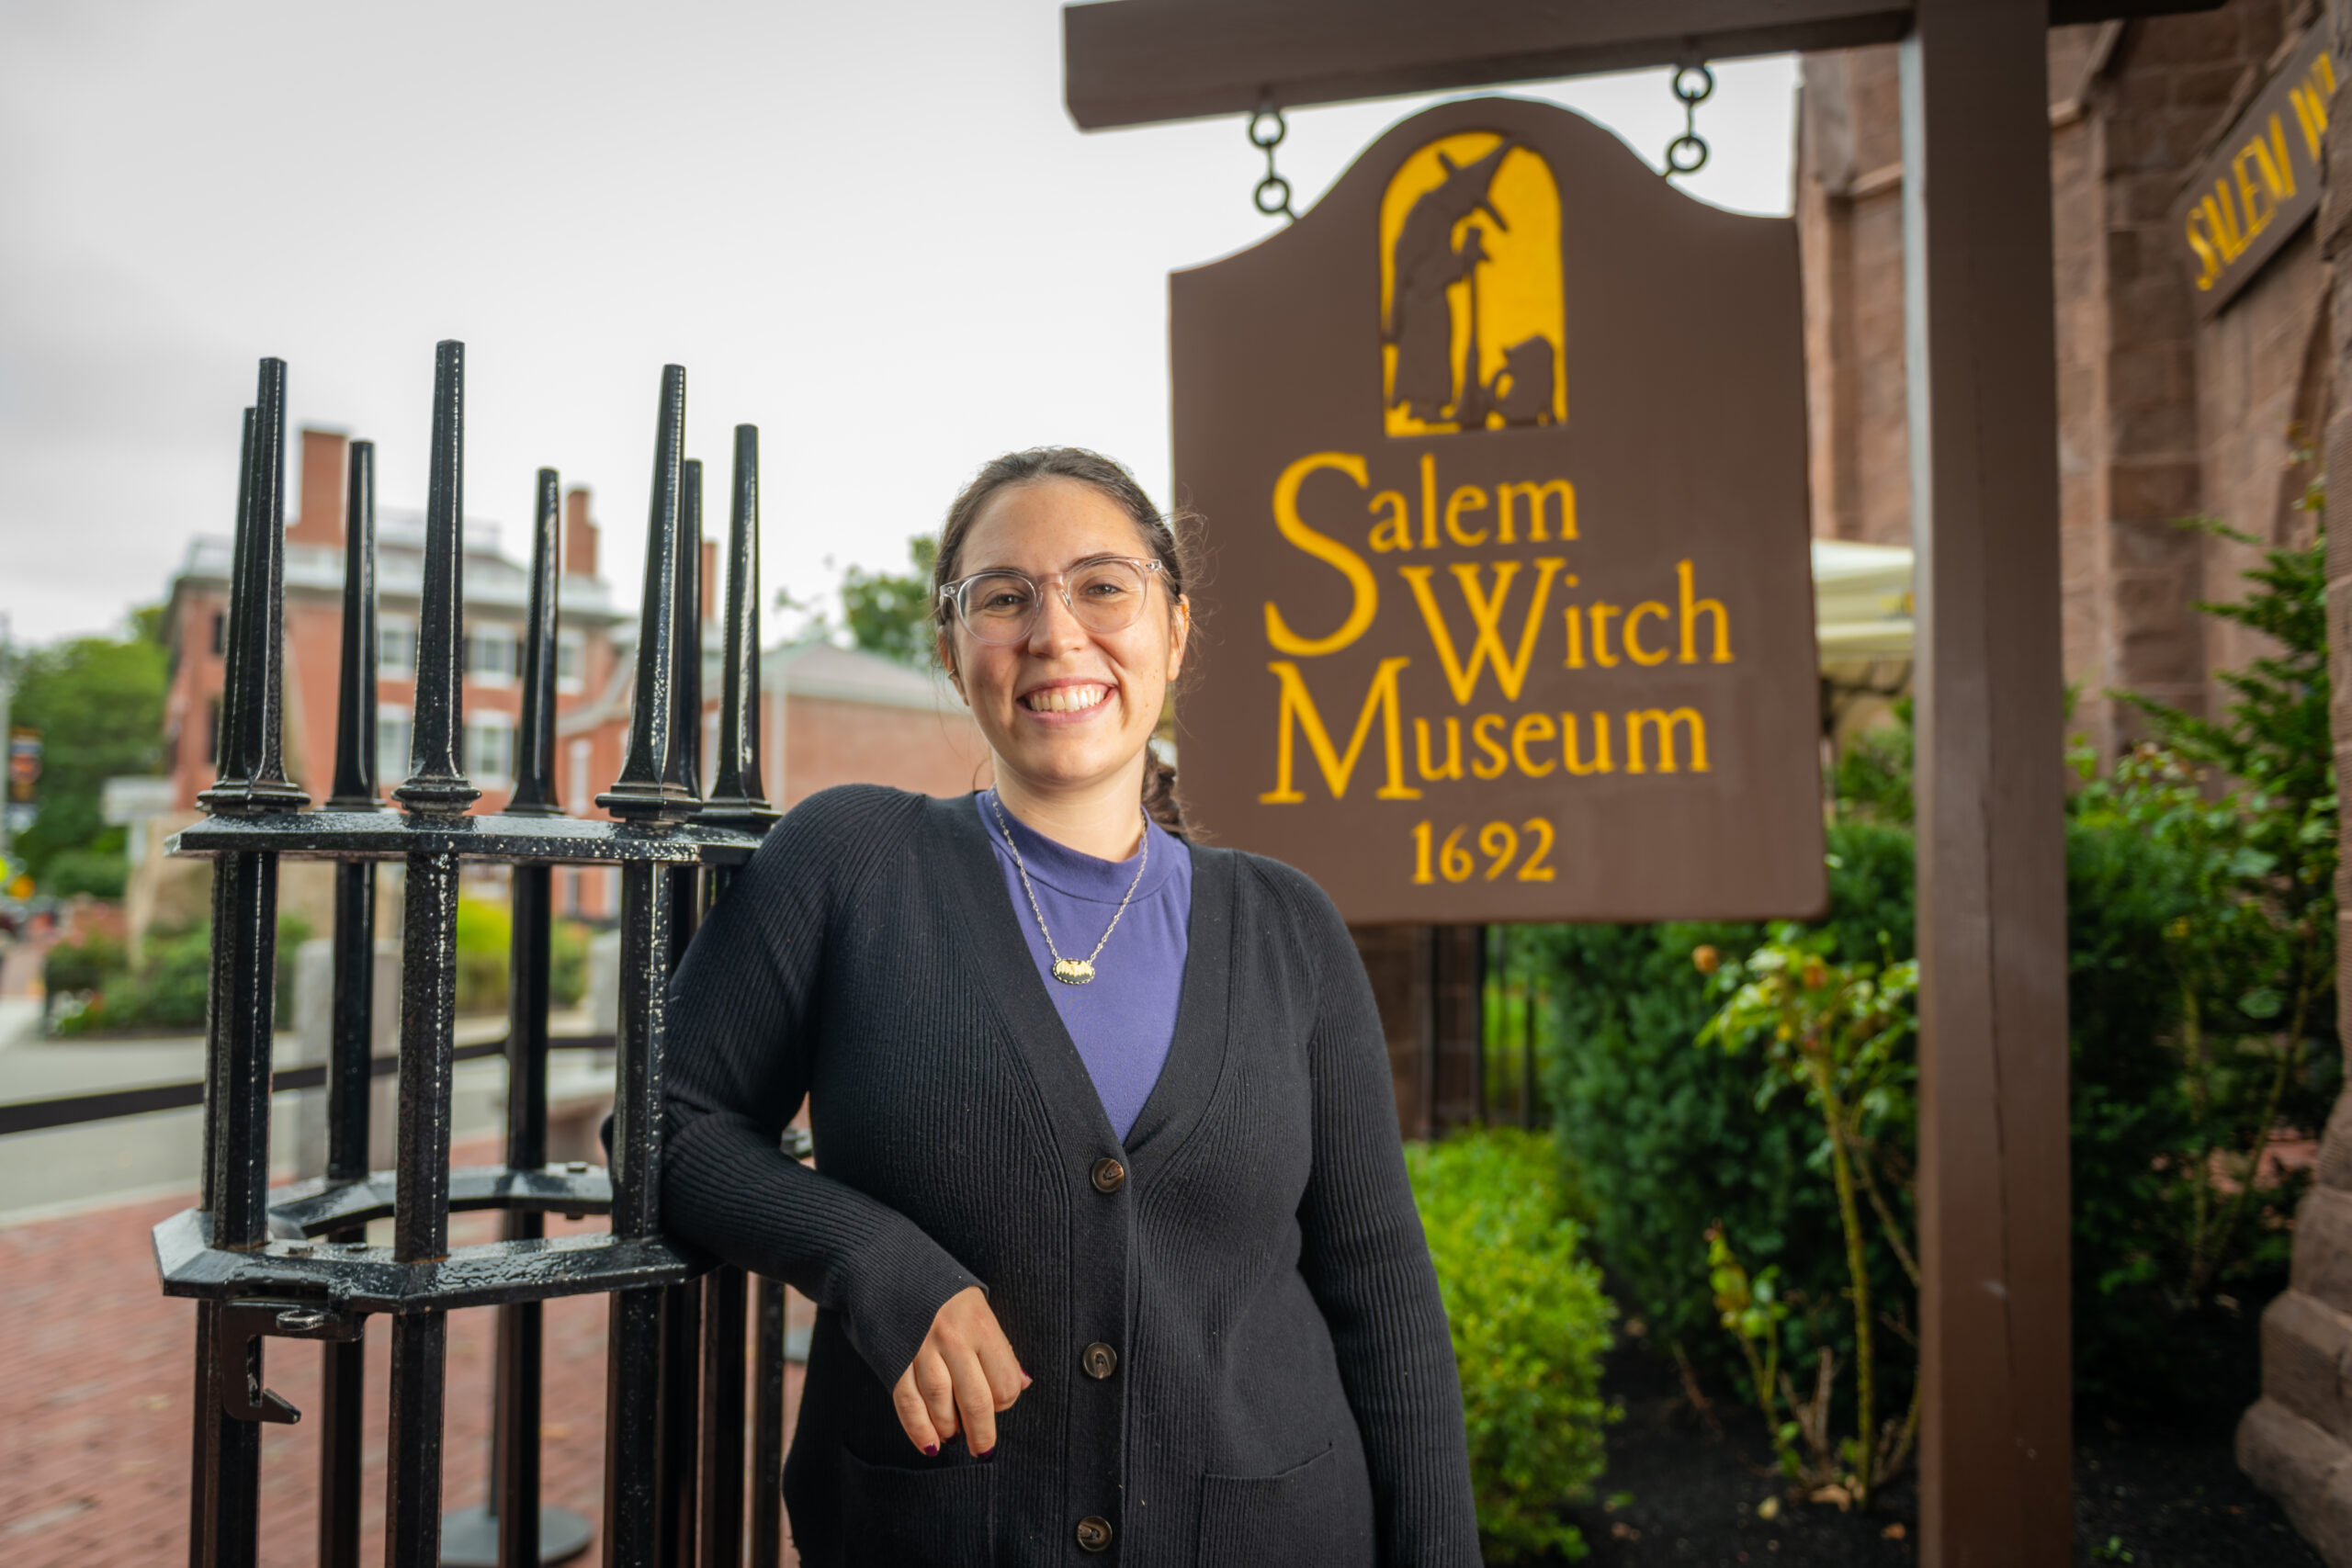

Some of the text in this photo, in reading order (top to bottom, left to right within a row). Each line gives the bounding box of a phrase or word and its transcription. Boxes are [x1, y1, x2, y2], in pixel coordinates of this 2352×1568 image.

[1264, 451, 1579, 657] Salem
[1398, 557, 1734, 705] Witch
[1258, 656, 1711, 805] Museum
[1410, 817, 1555, 885] 1692
